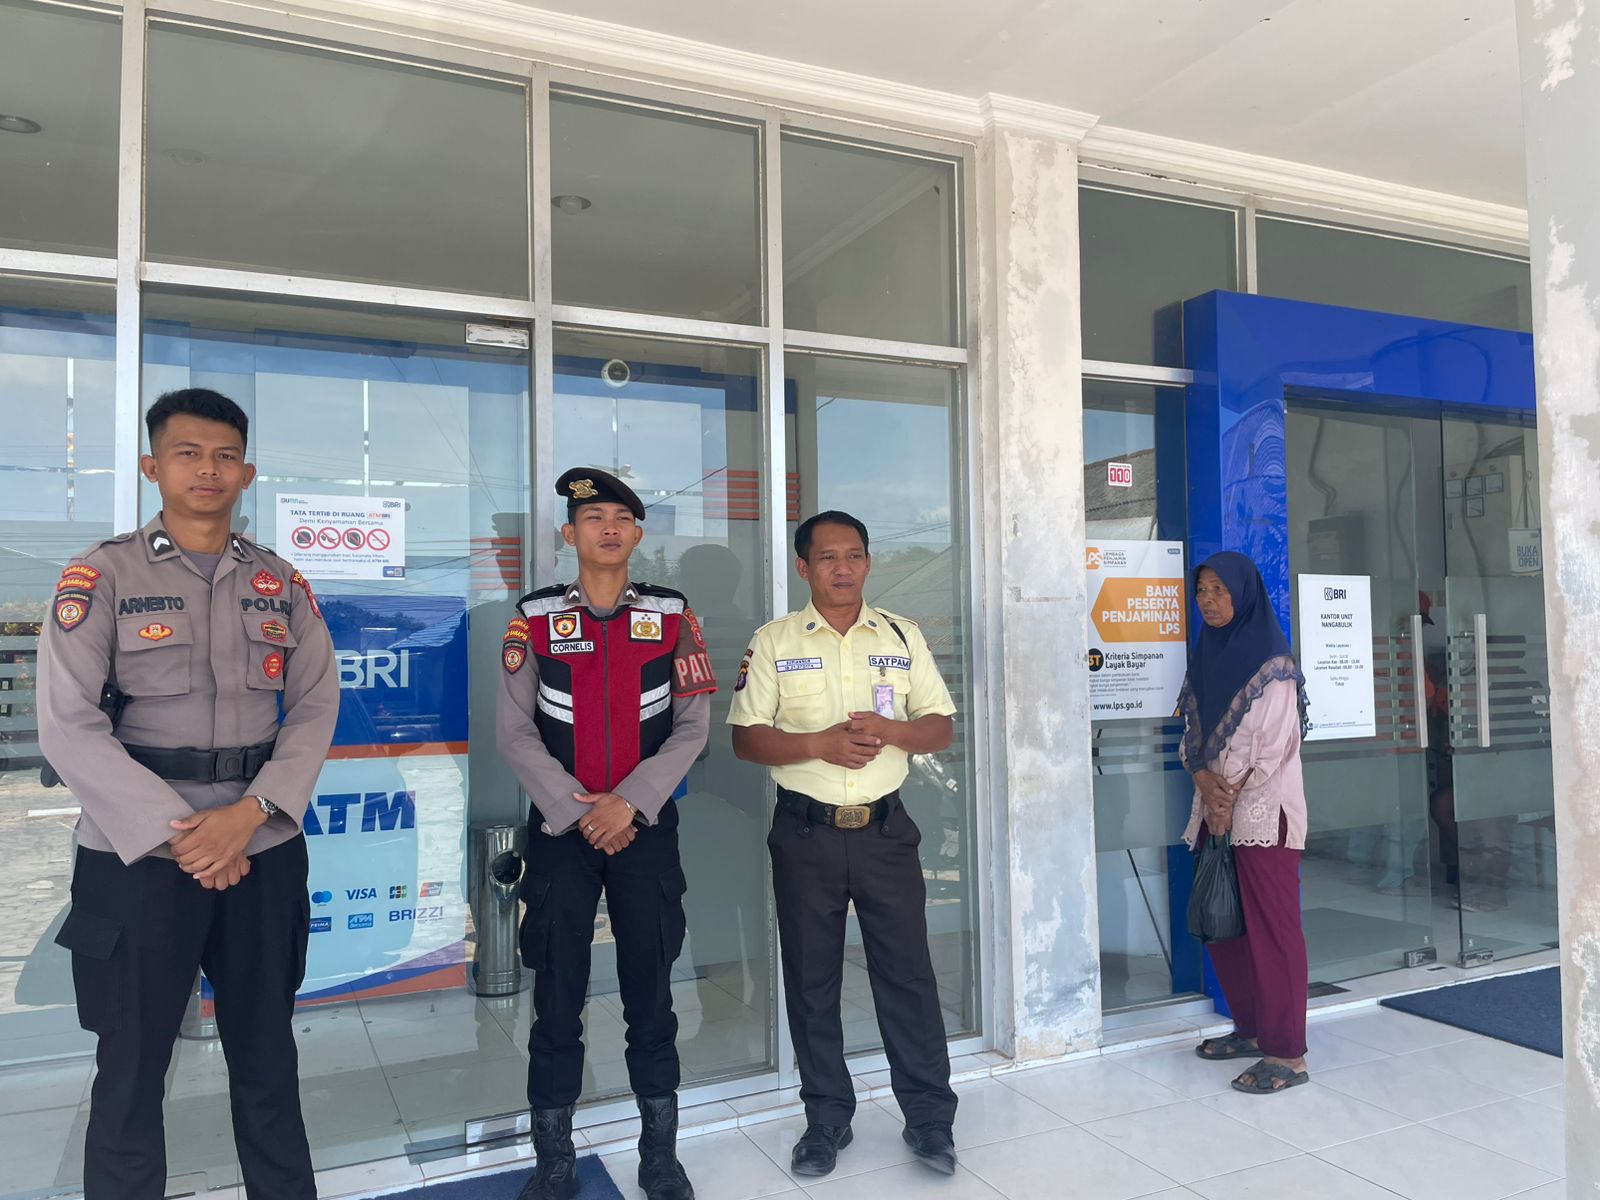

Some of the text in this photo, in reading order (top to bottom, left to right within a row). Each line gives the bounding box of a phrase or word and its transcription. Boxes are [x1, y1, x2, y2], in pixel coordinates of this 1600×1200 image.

[1110, 468, 1130, 483] 110
[317, 518, 356, 526] Kenyamanan
[1517, 545, 1538, 556] BUKA
[1519, 557, 1539, 568] OPEN
[1146, 586, 1178, 597] BANK
[1333, 589, 1346, 600] BRI
[118, 596, 184, 616] ARNESTO
[1127, 598, 1180, 610] PESERTA
[1102, 610, 1180, 623] PENJAMINAN
[1159, 624, 1180, 635] LPS
[552, 642, 592, 652] CORNELIS
[1105, 652, 1130, 660] Kriteria
[1131, 652, 1164, 662] Simpanan
[871, 657, 910, 669] SATPAM
[1105, 660, 1146, 670] Layak Bayar
[335, 649, 409, 689] BRI
[674, 653, 716, 688] PAT
[1094, 701, 1143, 711] www.lps.go.id
[344, 887, 377, 900] VISA
[389, 885, 407, 900] JCB
[389, 906, 443, 922] BRIZZI
